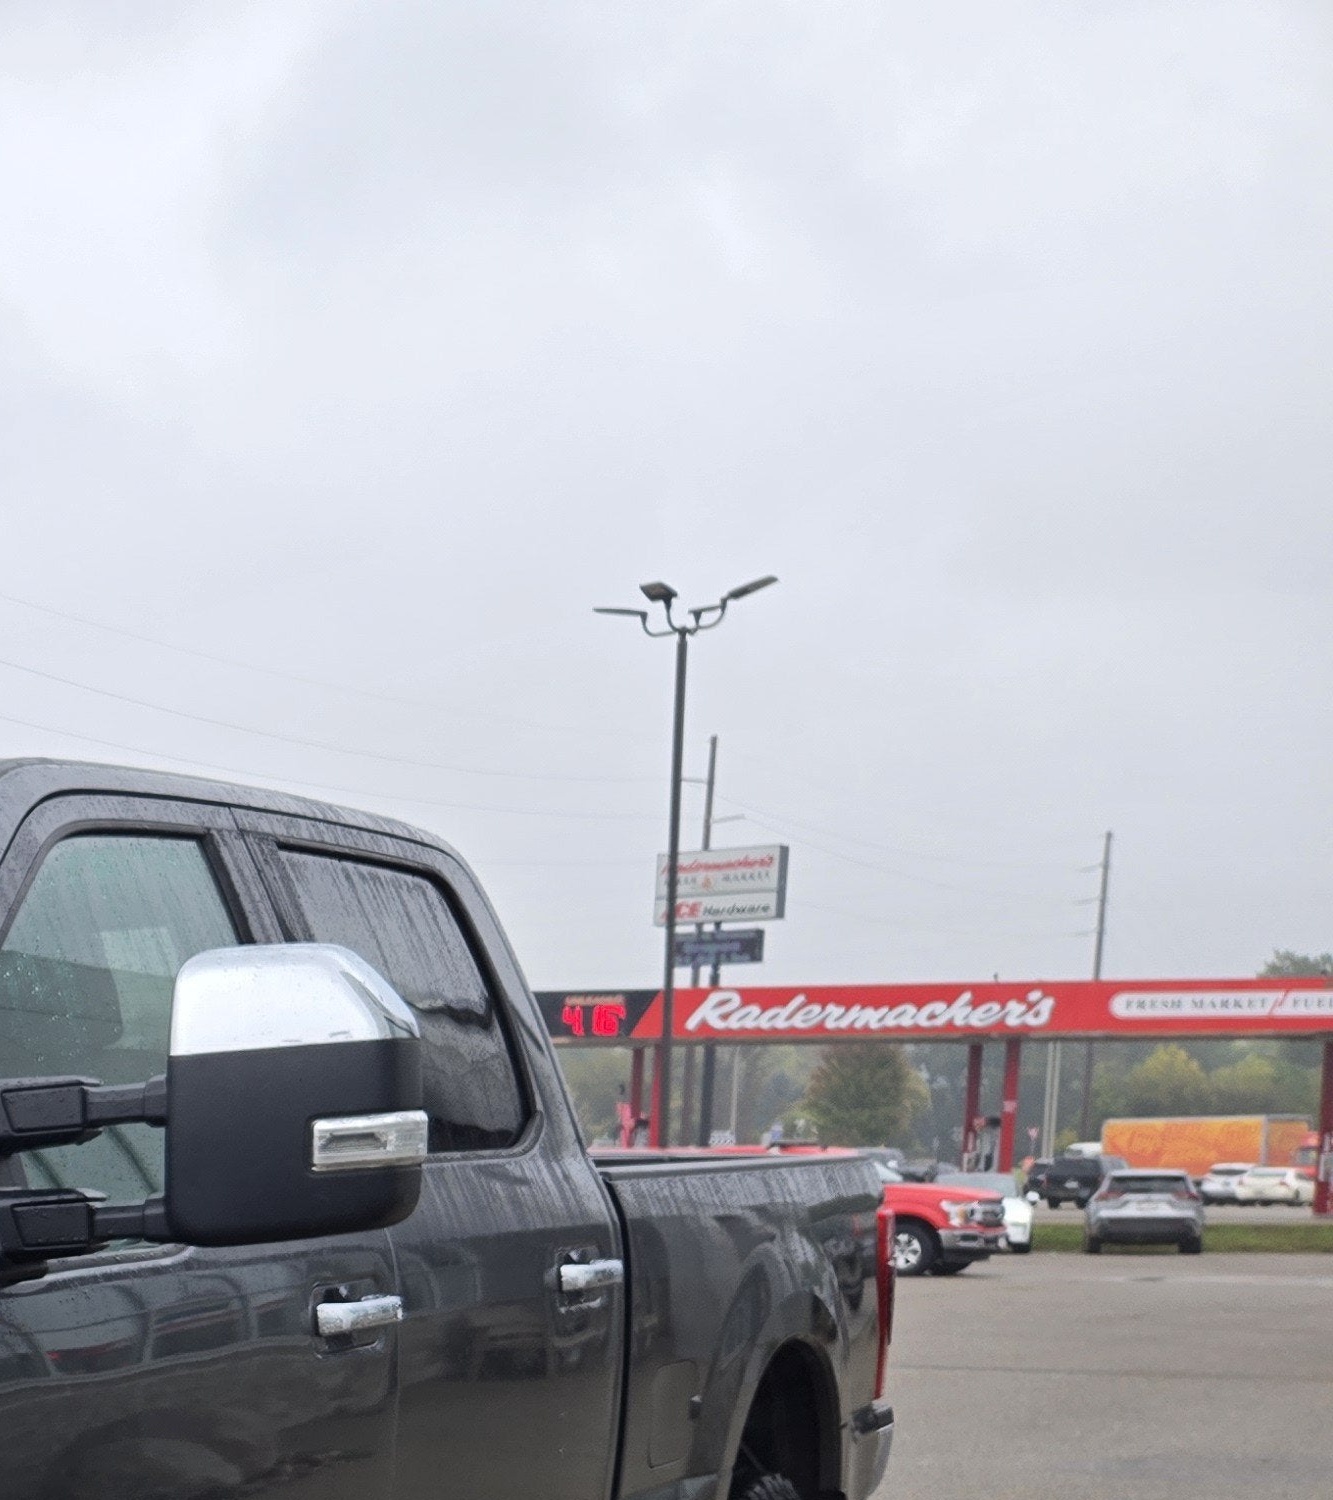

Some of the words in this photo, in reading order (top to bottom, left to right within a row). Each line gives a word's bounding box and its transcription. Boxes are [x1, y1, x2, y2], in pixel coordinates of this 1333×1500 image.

[703, 903, 771, 916] Hardware
[1191, 997, 1266, 1009] MARKET
[685, 990, 1055, 1032] Radermacher's
